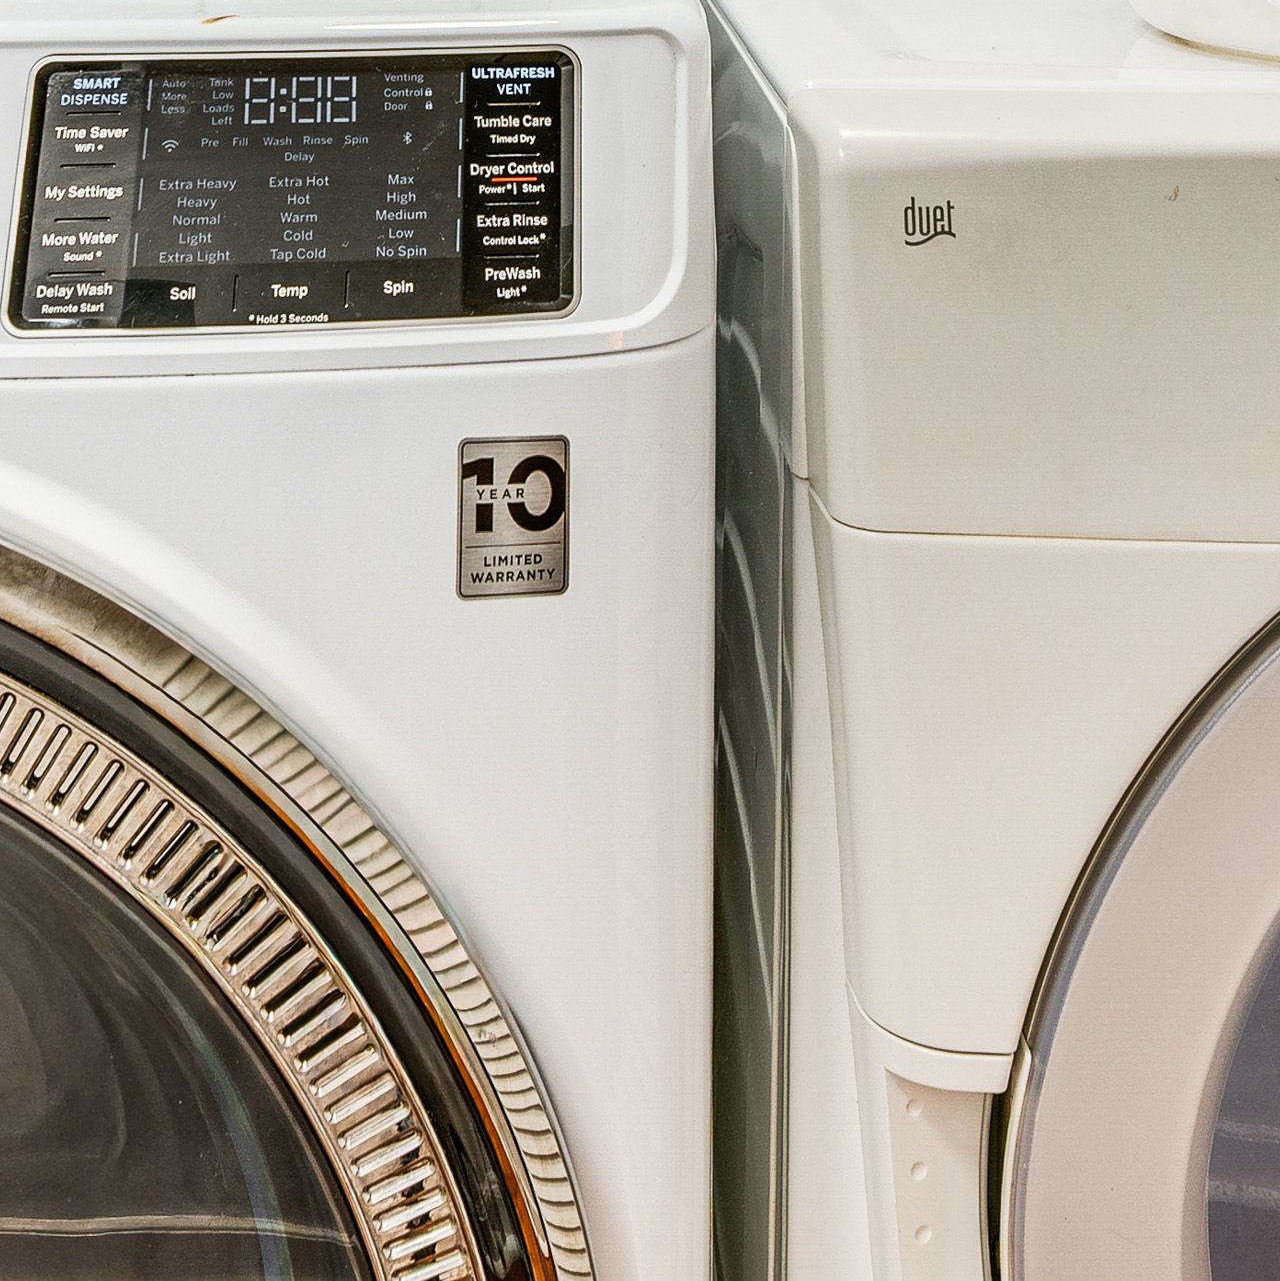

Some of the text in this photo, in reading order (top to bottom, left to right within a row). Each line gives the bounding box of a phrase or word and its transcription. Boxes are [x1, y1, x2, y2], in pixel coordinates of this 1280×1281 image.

[384, 74, 424, 83] Venting
[472, 67, 555, 79] ULTRAFRESH
[73, 78, 121, 90] SMART
[497, 83, 531, 95] VENT
[384, 88, 423, 97] Control
[61, 93, 128, 106] DISPENSE
[384, 102, 408, 111] Door
[474, 115, 552, 128] Tumble Care
[54, 126, 129, 140] Time Saver
[490, 134, 536, 145] Timed Dry
[285, 152, 315, 163] Delay
[470, 161, 555, 178] Dryer Control
[159, 178, 237, 191] Extra Heavy
[270, 176, 329, 188] Extra Hot
[388, 174, 414, 185] Max
[44, 185, 124, 201] My Settings
[387, 192, 416, 204] High
[177, 197, 217, 210] Heavy
[287, 194, 311, 205] Hot
[172, 214, 221, 226] Normal
[280, 212, 318, 223] Warm
[376, 210, 427, 220] Medium
[477, 214, 548, 227] Extra Rinse
[904, 196, 956, 246] duet
[179, 233, 212, 245] Light
[283, 230, 313, 241] Cold
[389, 228, 414, 238] Low
[42, 232, 119, 247] More Water
[159, 250, 230, 263] Extra Light
[270, 247, 327, 261] Tap Cold
[376, 246, 427, 258] No Spin
[485, 266, 541, 281] PreWash
[36, 283, 113, 299] Delay Wash
[170, 286, 196, 300] Soil
[271, 284, 309, 299] Temp
[384, 281, 414, 296] Spin
[41, 303, 105, 315] Remote Start
[462, 454, 566, 534] 10
[476, 488, 525, 500] YEAR
[484, 554, 542, 567] LIMITED
[471, 568, 555, 583] WARRANTY
